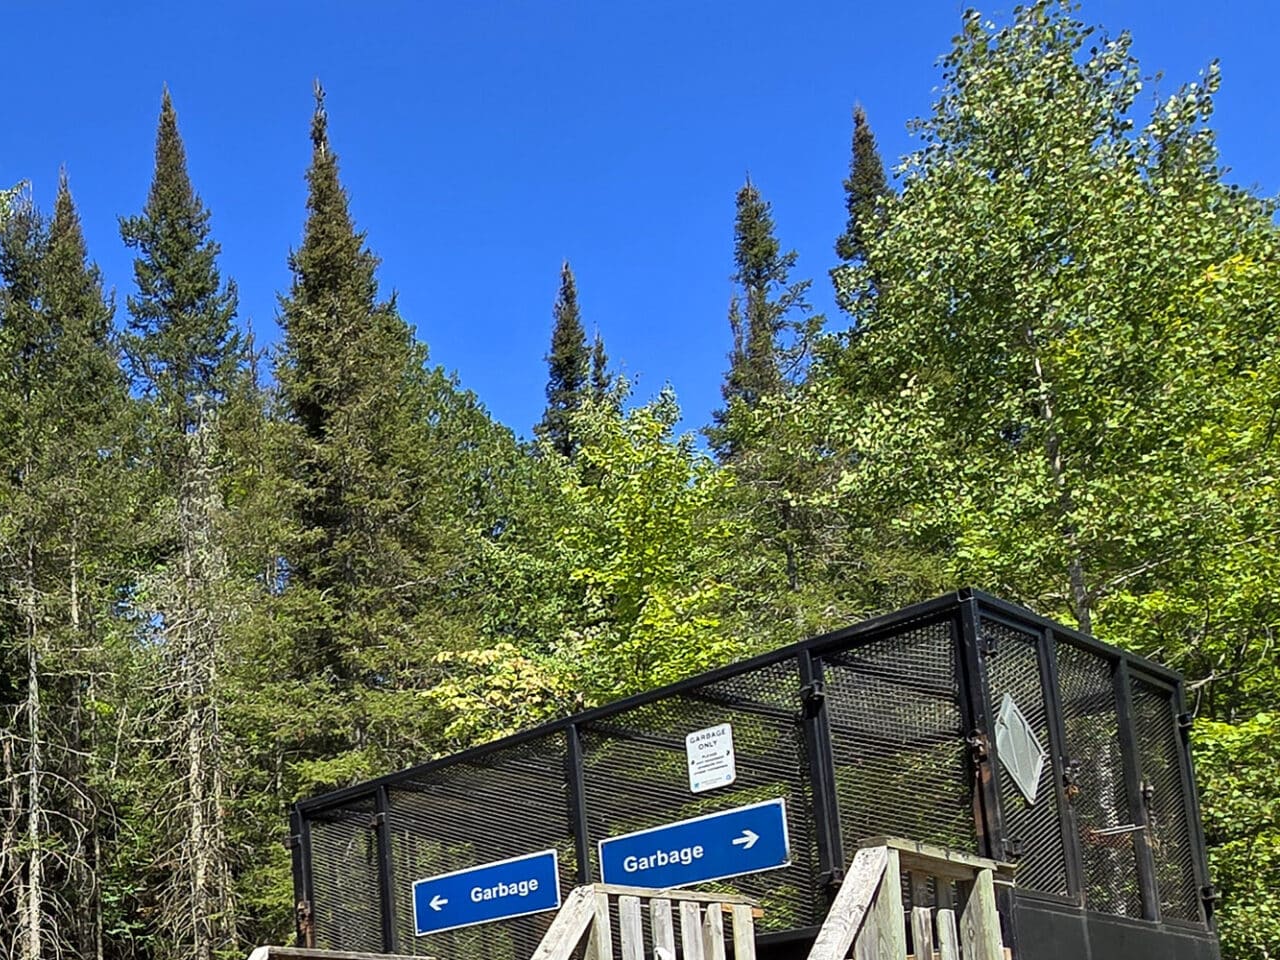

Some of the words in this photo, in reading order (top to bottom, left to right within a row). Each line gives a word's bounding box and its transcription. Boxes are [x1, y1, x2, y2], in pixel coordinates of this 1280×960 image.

[689, 728, 726, 744] GARBAGE
[698, 740, 717, 750] ONLY
[623, 845, 704, 872] Garbage
[470, 879, 538, 902] Garbage
